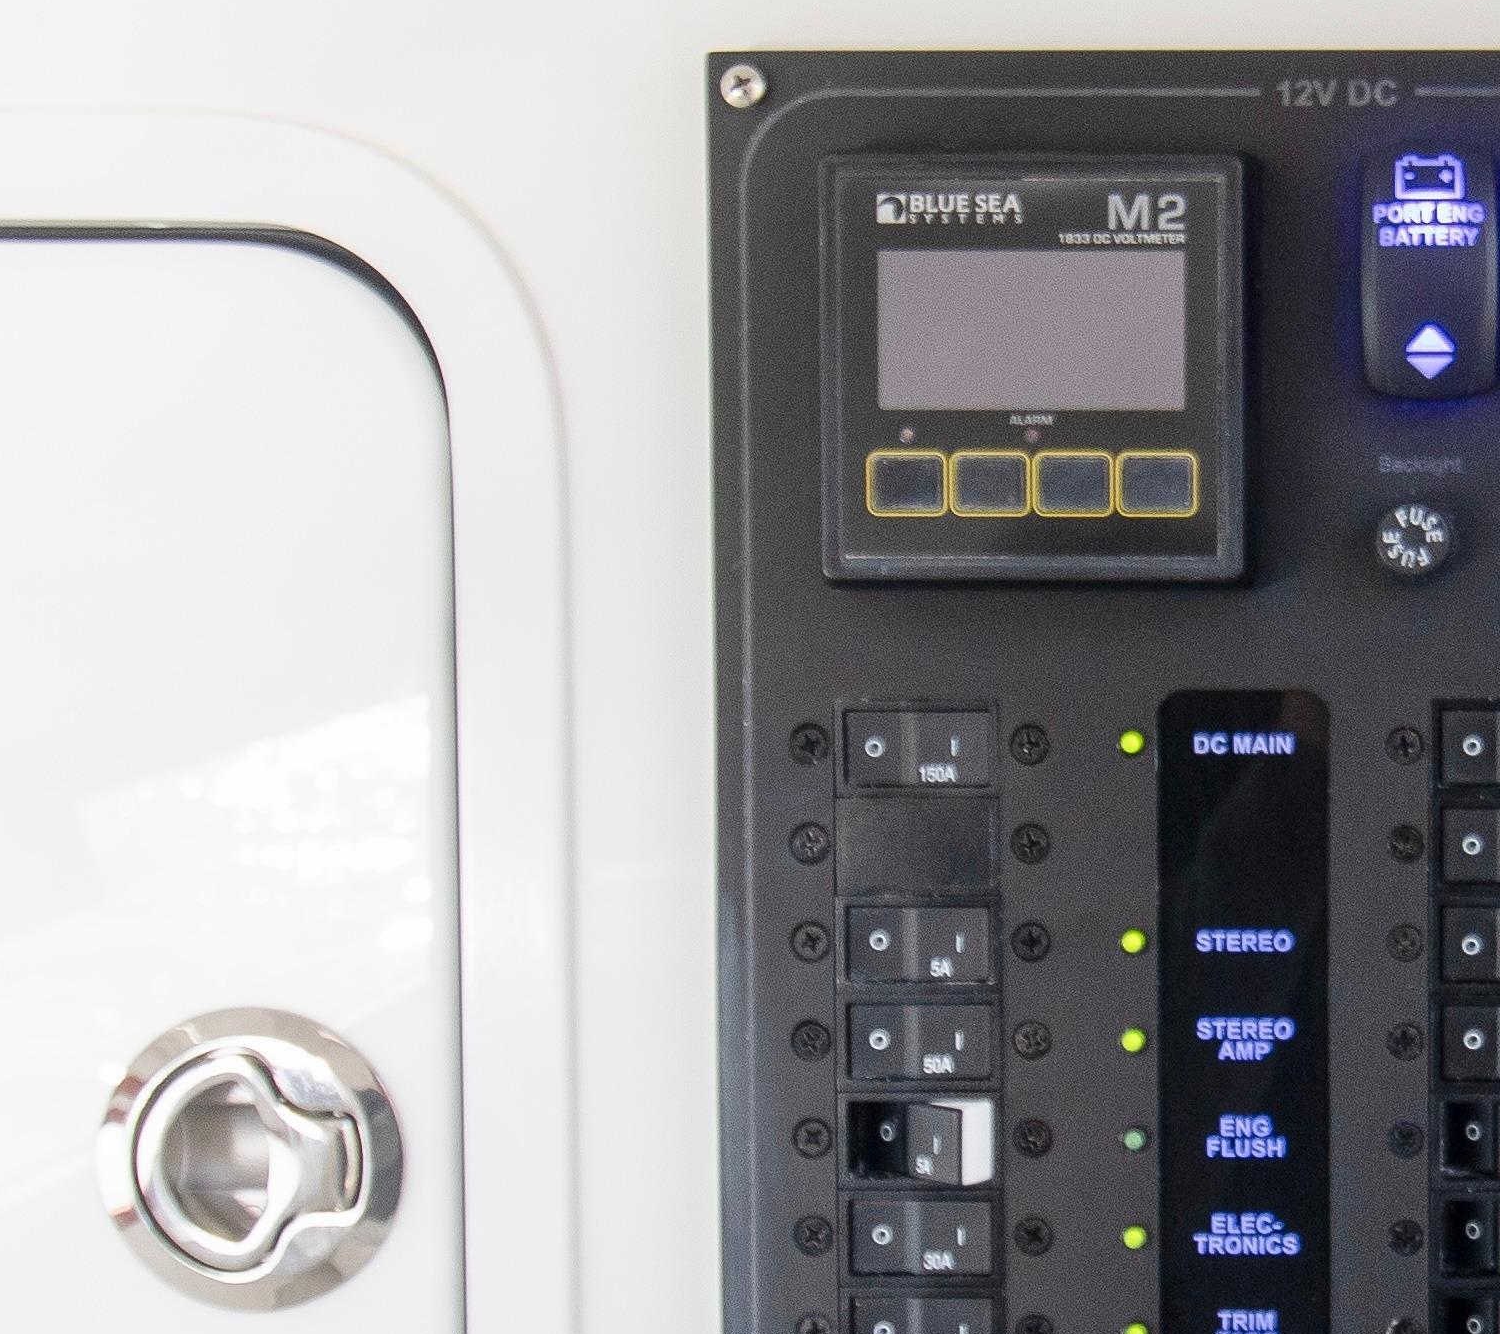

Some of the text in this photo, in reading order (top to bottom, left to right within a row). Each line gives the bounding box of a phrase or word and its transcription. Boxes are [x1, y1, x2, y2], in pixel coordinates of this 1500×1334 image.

[1276, 81, 1397, 107] 12V DC
[908, 194, 1021, 213] BLUE SEA
[1107, 194, 1186, 230] M2
[1372, 202, 1485, 224] PORT ENG
[909, 214, 1024, 224] SYSTEMS
[1114, 234, 1186, 244] VOLTMETER
[1380, 226, 1479, 247] BATTERY
[1395, 507, 1443, 542] FUSE
[1382, 531, 1429, 568] FUSE
[1193, 735, 1294, 755] DC MAIN
[918, 765, 955, 783] 150A
[1196, 930, 1294, 952] STEREO
[930, 959, 951, 977] 5A
[1196, 1020, 1294, 1041] STEREO
[1218, 1041, 1272, 1061] AMP
[923, 1056, 953, 1074] 50A
[1219, 1117, 1270, 1138] ENG
[1206, 1139, 1286, 1158] FLUSH
[1211, 1215, 1283, 1234] ELEC-
[1193, 1235, 1300, 1256] TRONICS
[1218, 1311, 1278, 1331] TRIM
